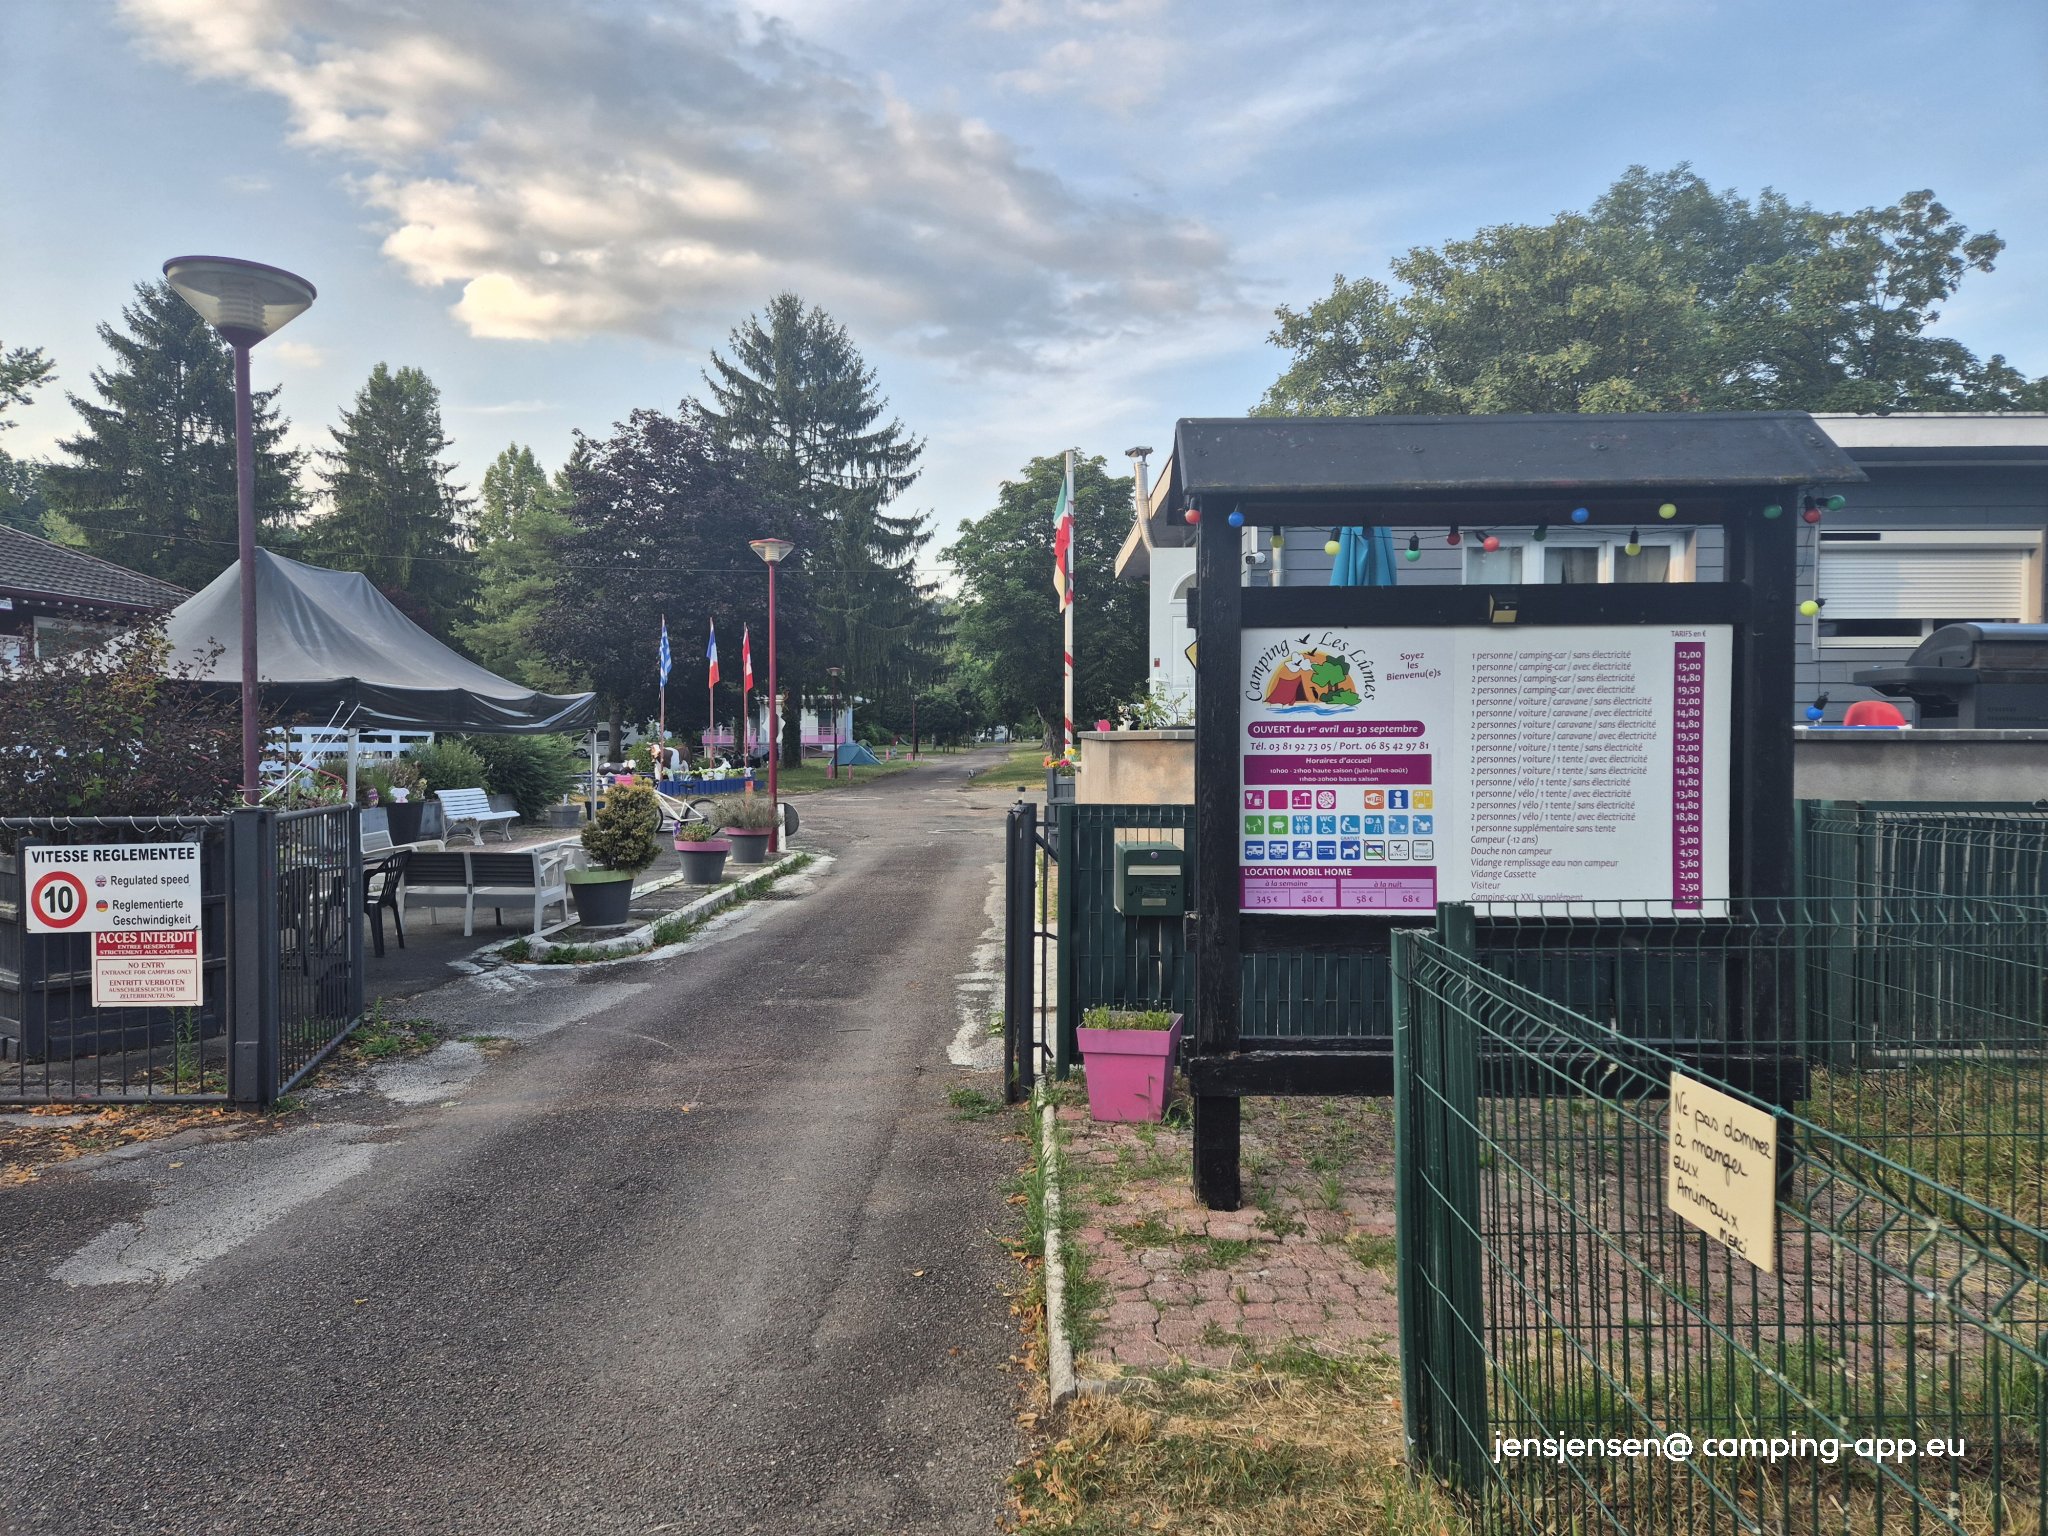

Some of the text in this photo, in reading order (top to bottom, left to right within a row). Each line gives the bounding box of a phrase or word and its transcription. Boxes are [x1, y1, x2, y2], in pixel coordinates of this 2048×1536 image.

[1400, 652, 1424, 661] Soyez
[1477, 652, 1513, 661] personne
[1519, 651, 1567, 661] camping-car
[1592, 650, 1631, 659] électricité
[1678, 651, 1702, 660] 12,00
[1246, 631, 1376, 702] Camping Les Lûmes
[1678, 663, 1701, 672] 15,00
[1387, 670, 1441, 680] Bienvenu(e)s
[1677, 674, 1701, 683] 14,80
[1678, 686, 1701, 695] 19,50
[1677, 698, 1701, 707] 12,00
[1677, 709, 1700, 718] 14,80
[1294, 725, 1305, 733] du
[1319, 724, 1339, 733] avril
[1370, 724, 1418, 734] septembre
[1676, 720, 1700, 729] 14,80
[1477, 733, 1517, 742] personnes
[1617, 732, 1657, 740] électricité
[1677, 732, 1700, 741] 19,50
[1251, 742, 1266, 750] Tél.
[1269, 743, 1280, 752] 03
[1283, 742, 1292, 750] 81
[1295, 743, 1305, 751] 92
[1308, 743, 1318, 752] 73
[1320, 743, 1332, 751] 05
[1340, 742, 1362, 750] Port.
[1365, 742, 1376, 750] 06
[1380, 742, 1390, 751] 85
[1393, 742, 1403, 751] 42
[1406, 742, 1416, 751] 97
[1419, 742, 1429, 750] 81
[1676, 744, 1700, 753] 12,00
[1676, 755, 1699, 764] 18,80
[1676, 767, 1699, 776] 14,80
[1677, 778, 1699, 788] 11,80
[1676, 790, 1699, 799] 13,80
[1676, 802, 1699, 811] 14,80
[1676, 813, 1699, 823] 18,80
[1476, 825, 1512, 833] personne
[1514, 824, 1574, 833] supplémentaire
[1679, 824, 1699, 834] 4,60
[1470, 835, 1538, 845] Campeur (-12 ans)
[1680, 837, 1699, 846] 3,00
[32, 847, 195, 864] VITESSE REGLEMENTEE
[1518, 848, 1552, 856] campeur
[1679, 848, 1699, 857] 4,50
[1471, 858, 1502, 867] Vidange
[1504, 858, 1550, 867] remplissage
[1679, 859, 1699, 869] 5,60
[1471, 870, 1536, 879] Vidange Cassette
[1680, 871, 1699, 880] 2,00
[110, 874, 189, 888] Regulated speed
[1471, 881, 1501, 889] Visiteur
[1680, 883, 1699, 892] 2,50
[44, 886, 73, 914] 10
[1356, 895, 1367, 903] 58
[112, 899, 184, 912] Reglementierte
[113, 914, 192, 927] Geschwindigkeit
[98, 931, 194, 943] ACCES INTERDIT
[1674, 1091, 1690, 1116] Ne
[1694, 1109, 1719, 1132] pas
[1675, 1122, 1749, 1187] à manger
[1673, 1154, 1699, 1179] aux
